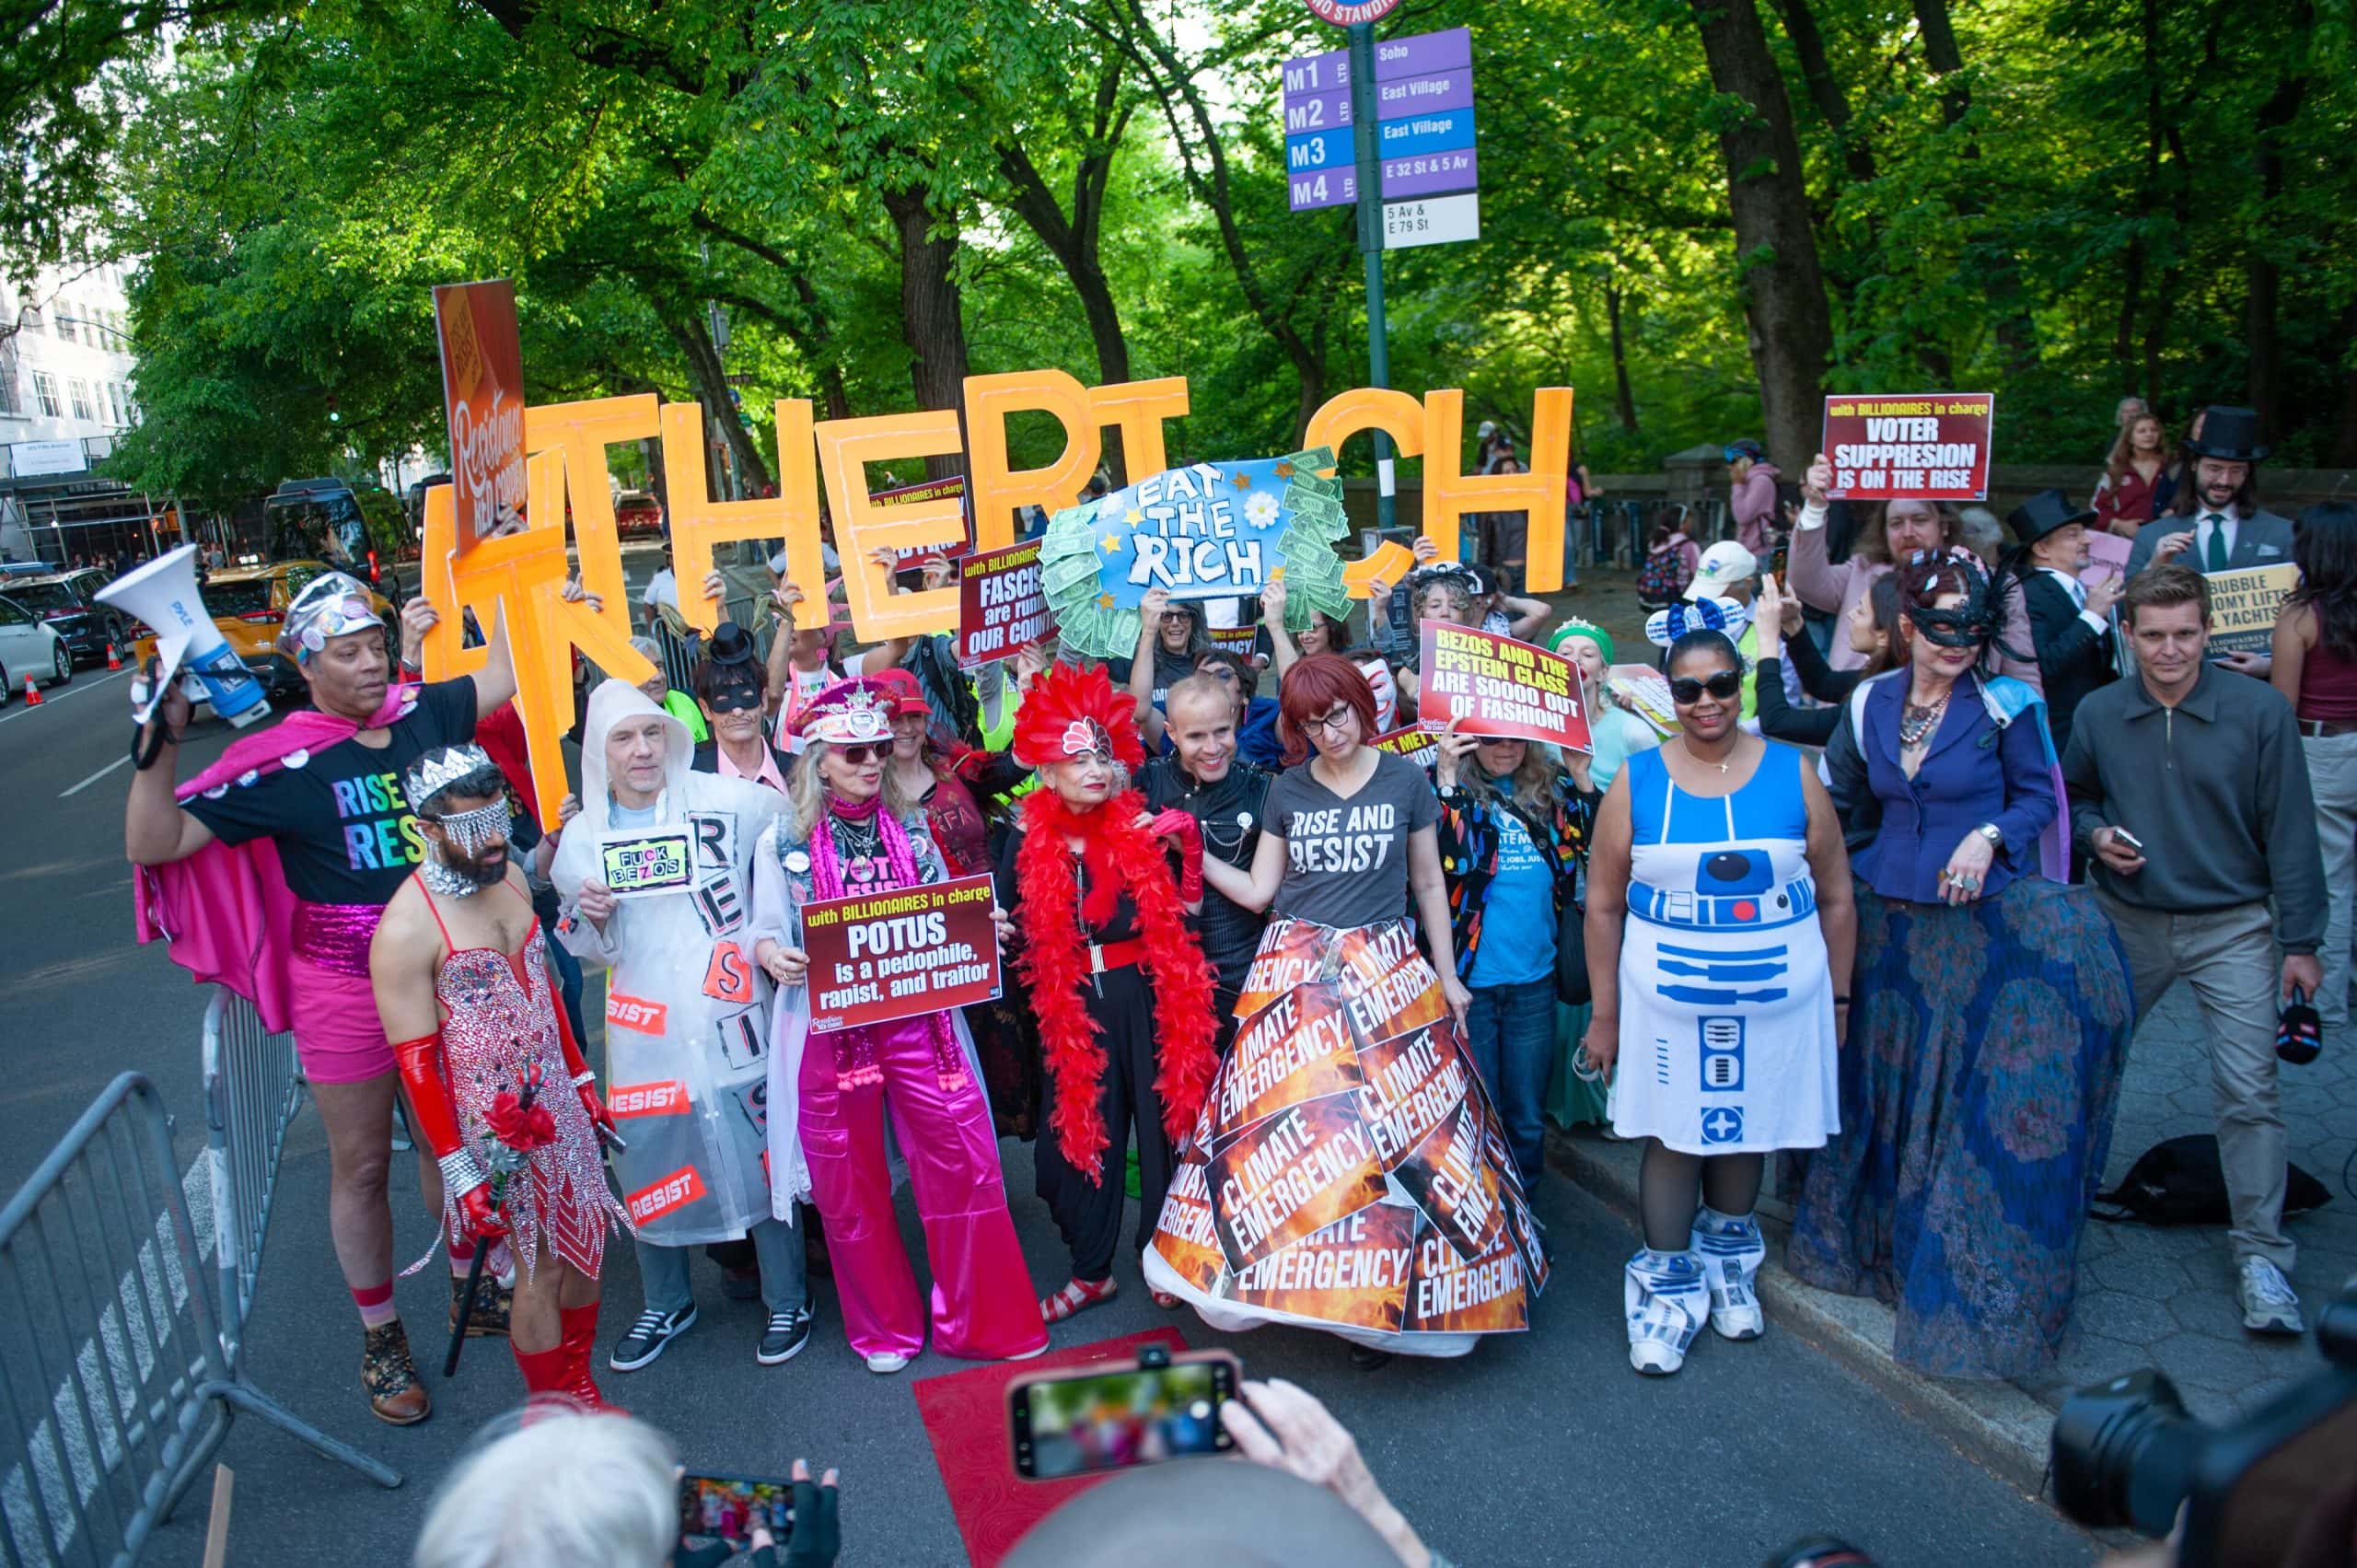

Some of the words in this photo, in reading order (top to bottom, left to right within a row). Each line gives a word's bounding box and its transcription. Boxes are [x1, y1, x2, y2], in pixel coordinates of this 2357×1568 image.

[1379, 46, 1409, 61] Soho
[1286, 60, 1319, 92] M1
[1338, 63, 1348, 84] LTD
[1382, 87, 1407, 100] East
[1410, 79, 1450, 96] Village
[1289, 99, 1324, 130] M2
[1340, 101, 1350, 122] LTD
[1384, 126, 1409, 139] East
[1411, 118, 1453, 135] Village
[1291, 137, 1326, 168] M3
[1387, 167, 1393, 178] E
[1397, 163, 1411, 176] 32
[1414, 161, 1426, 175] St
[1430, 161, 1439, 172] &
[1443, 158, 1449, 169] 5
[1453, 156, 1469, 168] Av
[1293, 175, 1329, 205] M4
[1344, 178, 1354, 198] LTD
[1387, 208, 1394, 219] 5
[1399, 205, 1412, 217] Av
[1417, 203, 1424, 215] &
[1388, 222, 1395, 234] E
[1399, 219, 1413, 232] 79
[1418, 216, 1429, 230] St
[1829, 403, 1855, 416] with
[1858, 402, 1932, 416] BILLIONAIRES
[1934, 403, 1945, 414] in
[1949, 401, 1989, 416] charge
[1866, 417, 1939, 443] VOTER
[1835, 444, 1977, 469] SUPPRESION
[1137, 462, 1224, 507] EAT
[1837, 470, 1855, 489] IS
[1861, 470, 1886, 489] ON
[1891, 470, 1924, 489] THE
[1930, 470, 1971, 489] RISE
[1145, 498, 1236, 539] THE
[964, 561, 986, 577] with
[1127, 532, 1262, 589] RICH
[980, 563, 1042, 608] FASCIS
[2209, 575, 2267, 595] BUBBLE
[984, 605, 1011, 626] are
[969, 626, 1004, 656] OUR
[1435, 629, 1493, 656] BEZOS
[1499, 643, 1535, 668] AND
[1538, 655, 1570, 681] THE
[1435, 650, 1509, 680] EPSTEIN
[1515, 669, 1569, 697] CLASS
[1433, 671, 1470, 693] ARE
[1476, 676, 1539, 706] SOOOO
[1545, 691, 1578, 717] OUT
[1451, 695, 1476, 718] OF
[1481, 697, 1566, 733] FASHION!
[1398, 731, 1428, 752] MET
[332, 772, 407, 818] RISE
[1291, 808, 1341, 837] RISE
[1346, 804, 1395, 832] AND
[343, 815, 427, 870] RES
[620, 846, 668, 867] FUCK
[1289, 833, 1394, 874] RESIST
[611, 859, 680, 884] BEZOS
[807, 911, 838, 927] with
[842, 894, 928, 922] BILLIONAIRES
[933, 892, 945, 907] in
[948, 886, 991, 904] charge
[847, 912, 947, 958] POTUS
[834, 963, 854, 983] is
[860, 962, 873, 979] a
[877, 943, 978, 979] pedophile,
[1341, 921, 1416, 997] CLIMATE
[819, 983, 885, 1010] rapist,
[890, 972, 927, 997] and
[932, 962, 990, 990] traitor
[1349, 956, 1439, 1036] EMERGEN
[1225, 993, 1298, 1090] CLIMATE
[1220, 1009, 1344, 1123] EMERGENCY
[1359, 1028, 1442, 1121] CLIMATE
[1370, 1059, 1468, 1162] EMERGENC
[1223, 1107, 1316, 1213] CLIMATE
[632, 1173, 692, 1221] RESIST
[1230, 1120, 1368, 1256] EMERGENCY
[1238, 1248, 1410, 1290] EMERGENCY
